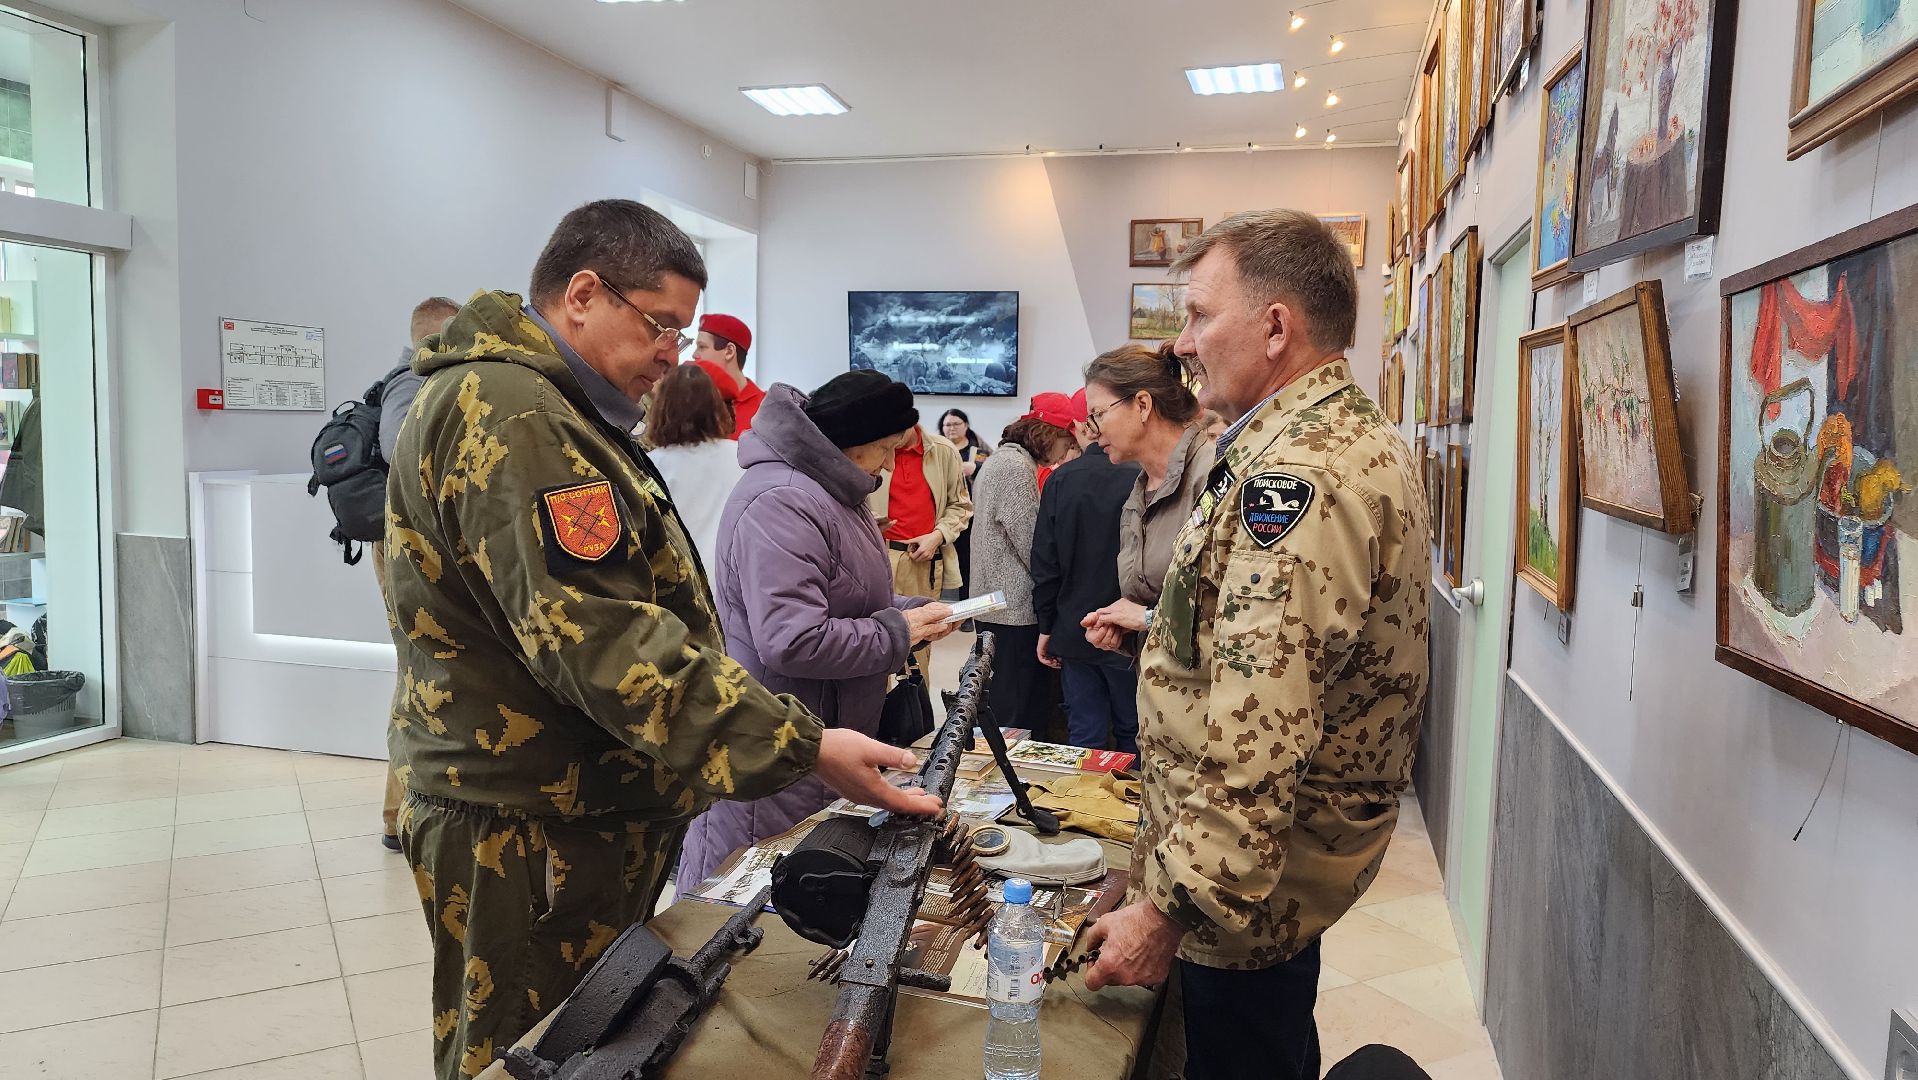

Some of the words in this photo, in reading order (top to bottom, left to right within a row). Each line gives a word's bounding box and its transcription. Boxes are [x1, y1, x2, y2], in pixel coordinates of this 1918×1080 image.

[1254, 479, 1297, 489] ПОИСКОВОЕ
[570, 486, 608, 498] СОТНИК
[1249, 512, 1289, 523] ДВИЖЕНИЕ
[1253, 523, 1281, 533] РОССИИ
[583, 542, 605, 553] РУЗА
